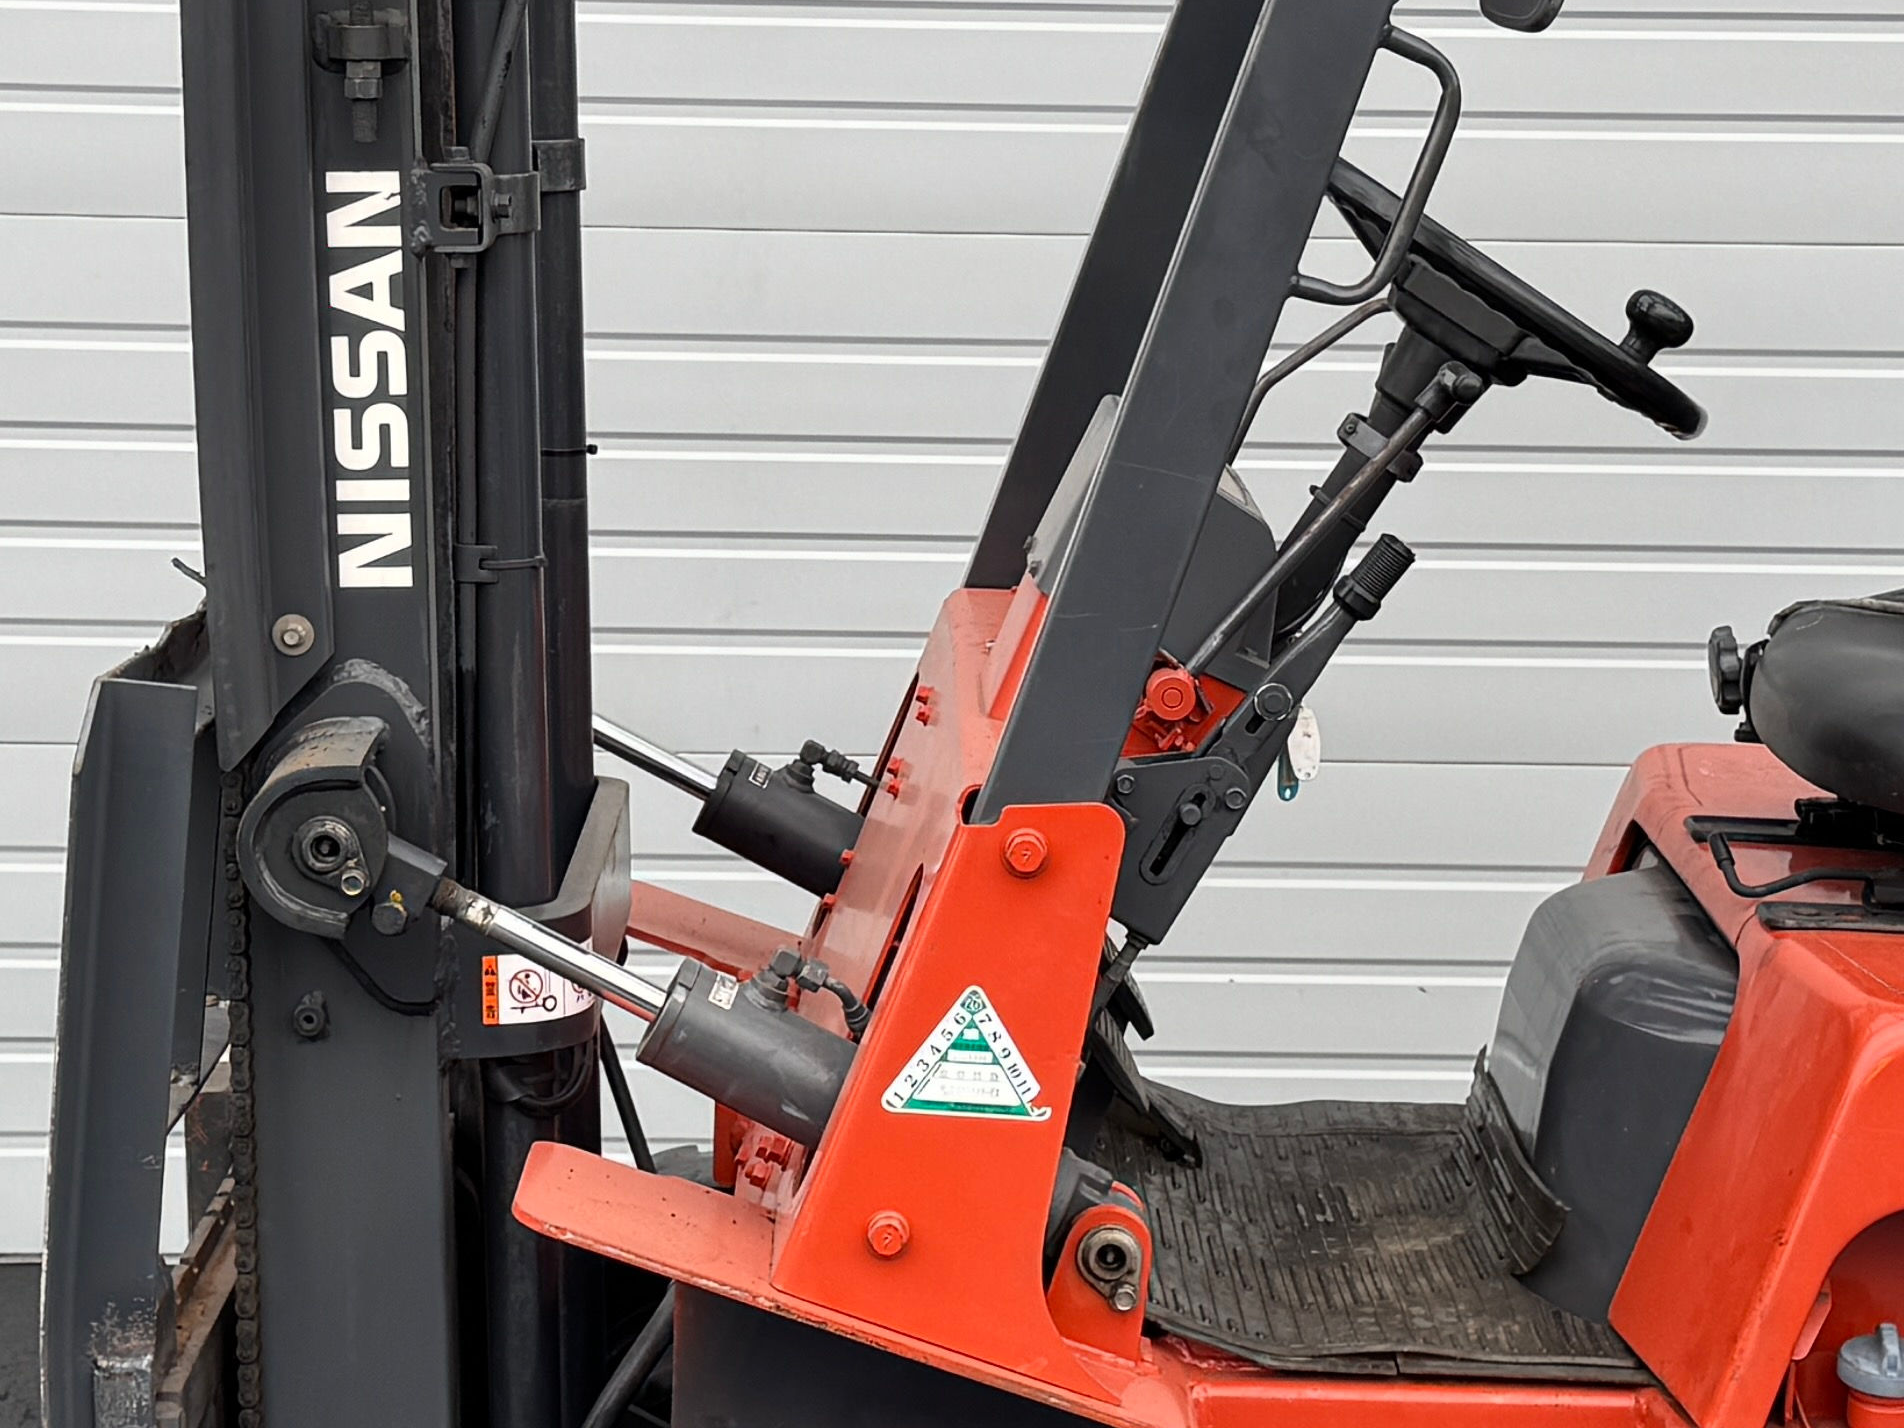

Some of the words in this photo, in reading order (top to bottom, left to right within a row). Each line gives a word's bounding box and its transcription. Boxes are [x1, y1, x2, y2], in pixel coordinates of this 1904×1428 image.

[325, 170, 414, 589] NISSAN
[894, 1091, 904, 1102] 1
[904, 1074, 918, 1088] 2
[916, 1059, 930, 1072] 3
[930, 1044, 942, 1056] 4
[941, 1028, 954, 1042] 5
[954, 1012, 966, 1025] 6
[978, 1013, 992, 1023] 7
[998, 1047, 1011, 1059] 9
[1007, 1063, 1022, 1079] 10
[1016, 1079, 1031, 1096] 11
